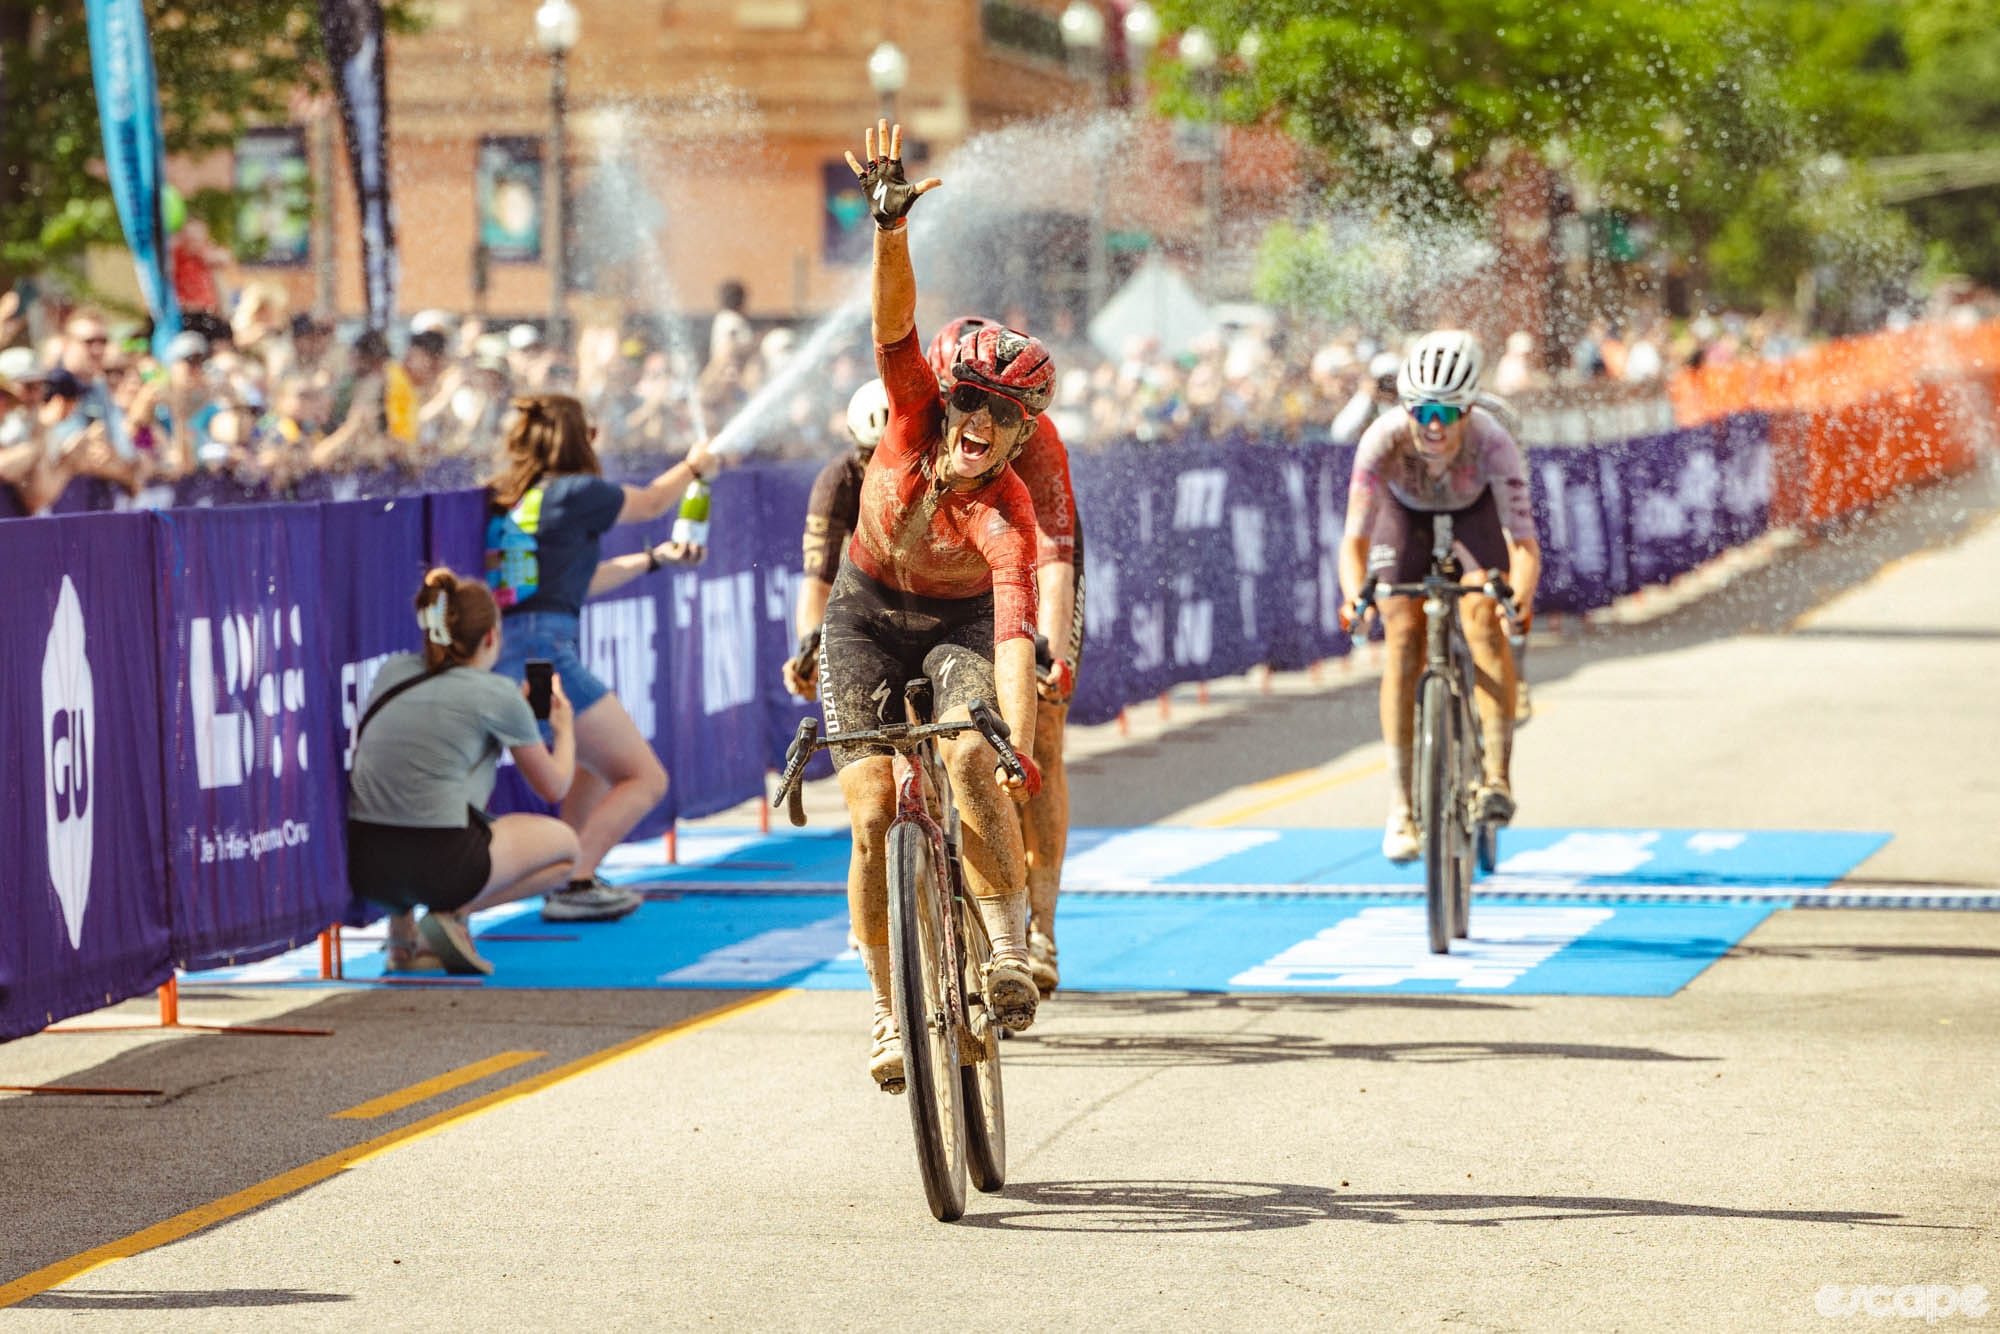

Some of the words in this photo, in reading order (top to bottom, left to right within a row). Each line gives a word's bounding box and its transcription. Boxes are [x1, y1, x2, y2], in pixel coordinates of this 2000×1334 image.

[819, 623, 840, 734] SPECIALIZED
[52, 707, 88, 822] GU
[990, 733, 1021, 769] SRAM
